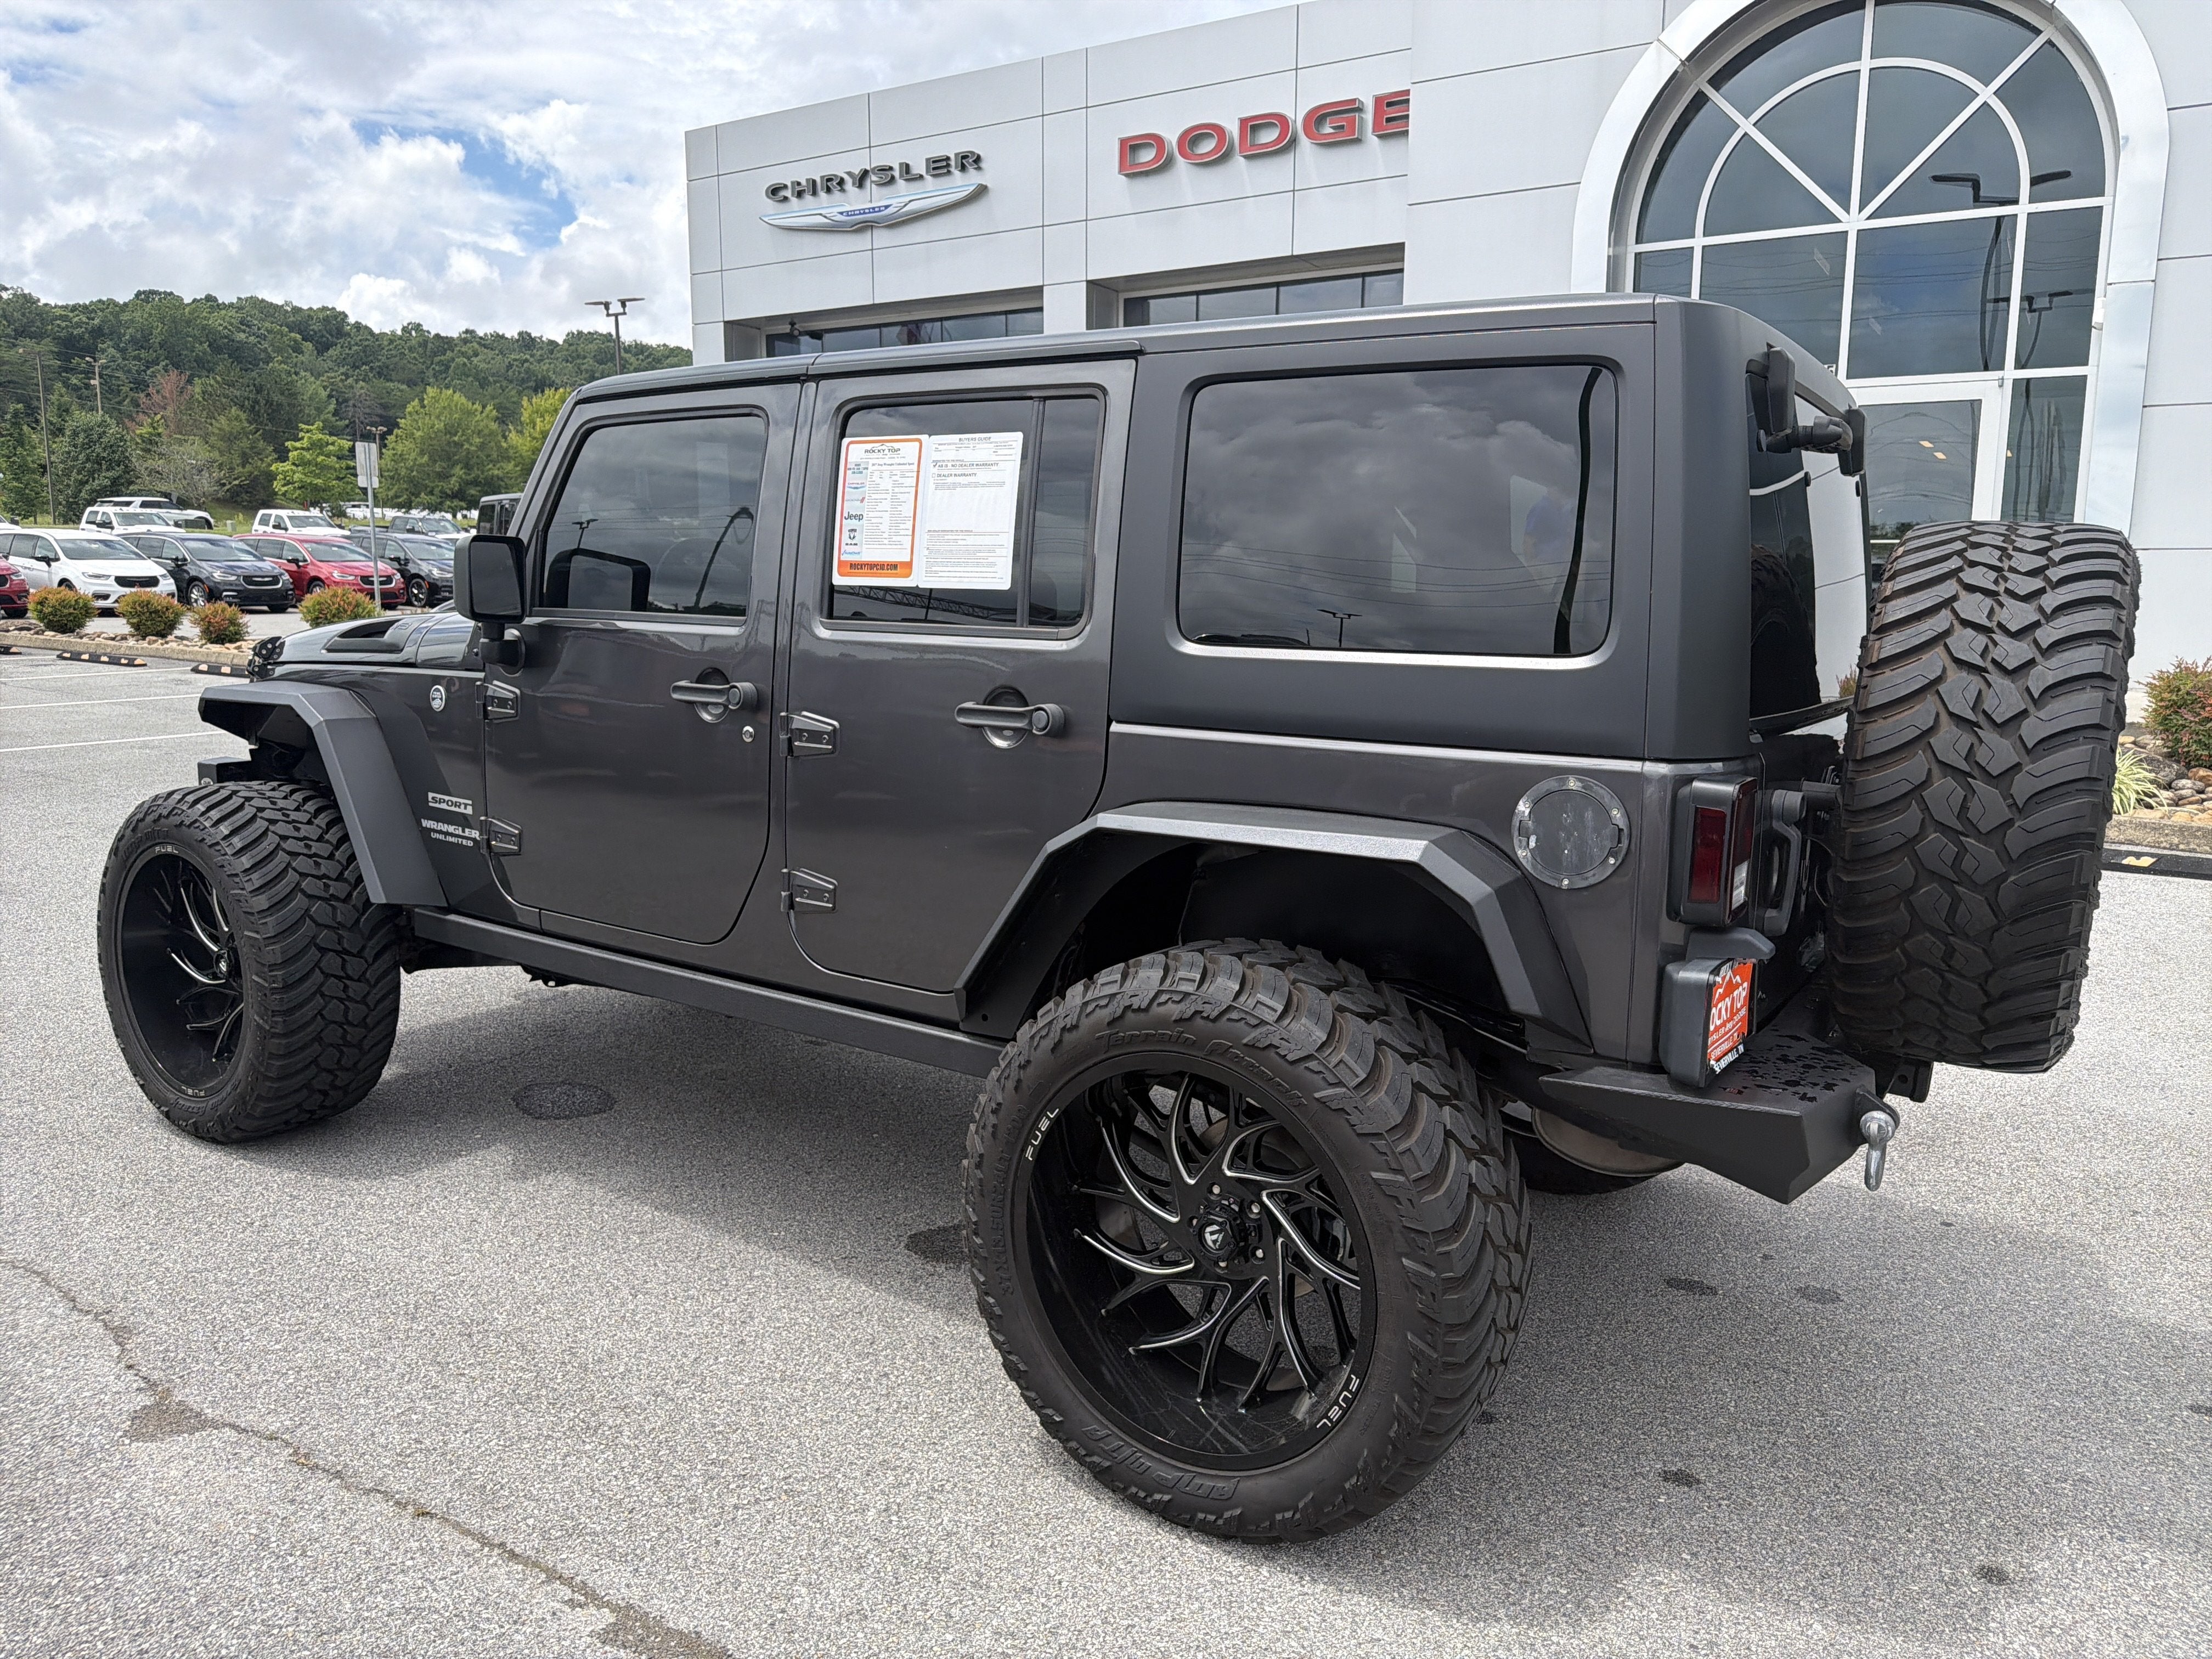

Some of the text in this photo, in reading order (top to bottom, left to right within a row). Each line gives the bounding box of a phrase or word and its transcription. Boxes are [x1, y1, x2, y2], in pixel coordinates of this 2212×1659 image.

[1118, 89, 1408, 177] DODGE
[764, 149, 982, 201] CHRYSLER
[843, 206, 885, 216] CHRYSLER
[844, 511, 864, 522] Jeep
[849, 563, 898, 571] ROCKYTOPCJD.COM
[431, 796, 472, 811] SPORT
[421, 819, 480, 840] WRANGLER
[431, 832, 473, 847] UNLIMITED
[155, 845, 179, 854] FUEL
[1710, 981, 1748, 1031] OCKY TOP
[1096, 1028, 1197, 1053] Terrain
[181, 1086, 205, 1096] FUEL
[1025, 1106, 1059, 1161] FUEL
[1317, 1376, 1360, 1429] FUEL
